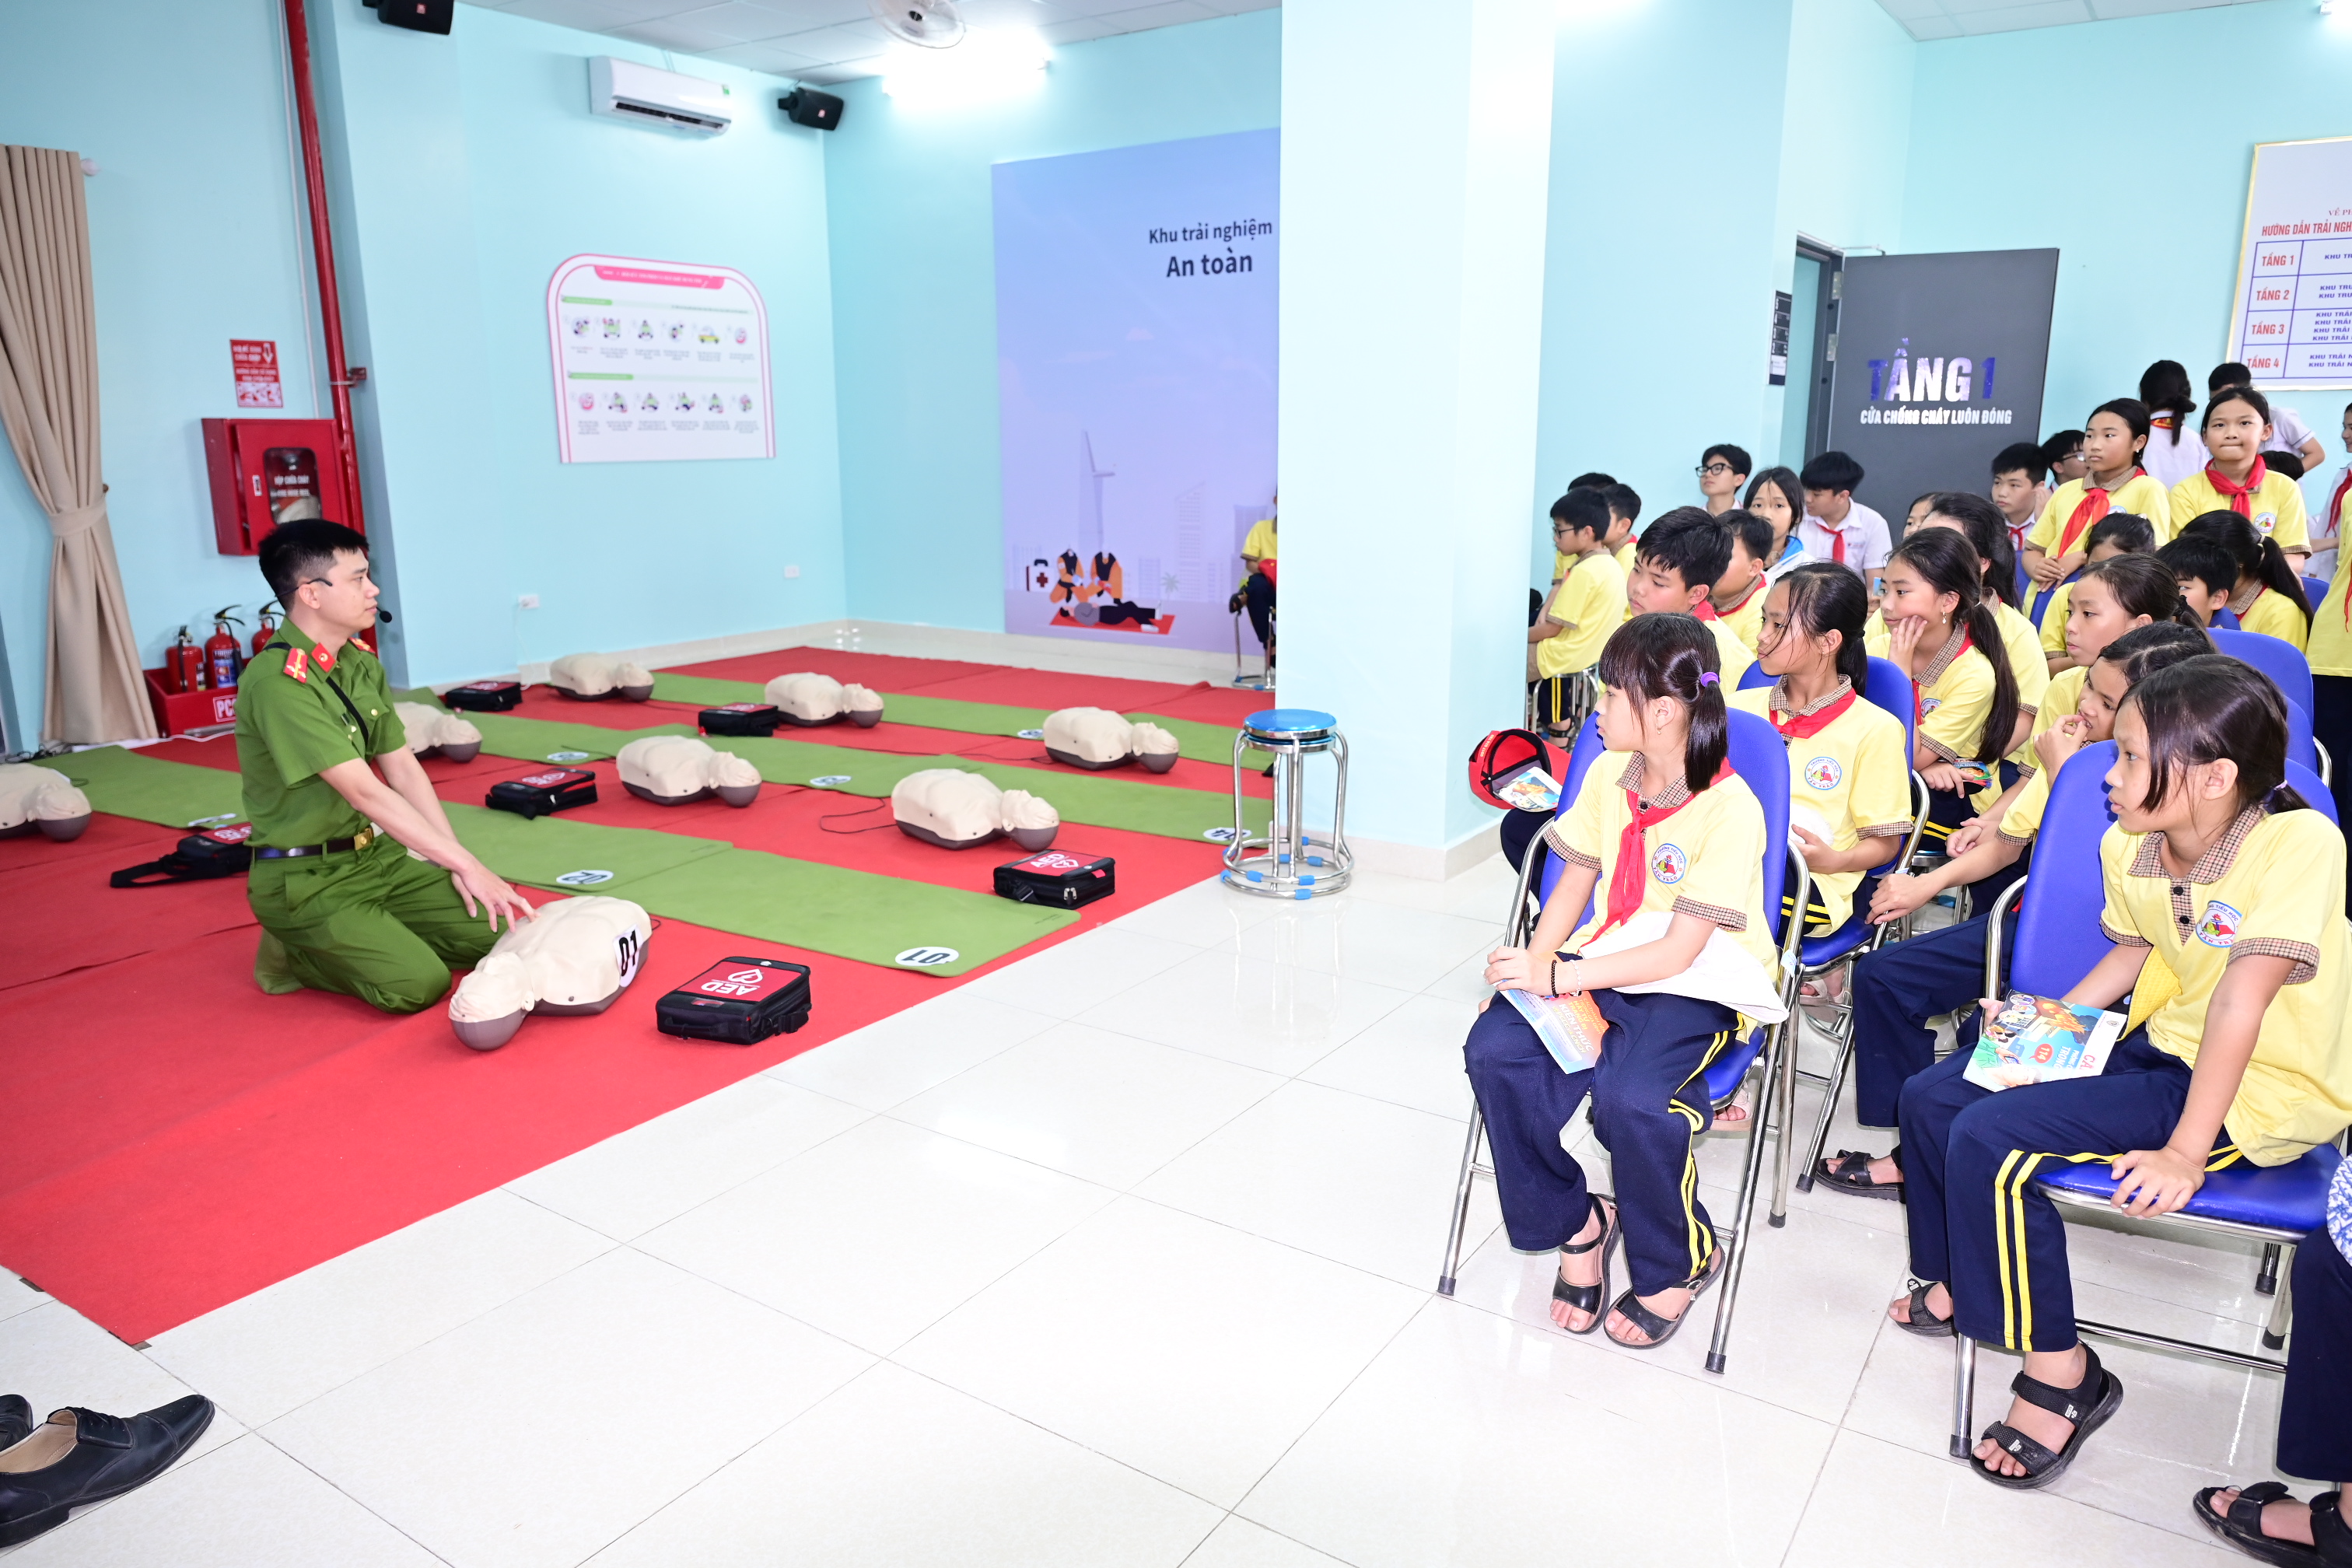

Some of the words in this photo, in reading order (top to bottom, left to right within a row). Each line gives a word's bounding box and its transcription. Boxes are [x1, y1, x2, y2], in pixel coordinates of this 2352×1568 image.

[1149, 227, 1178, 244] Khu
[1182, 222, 1209, 241] trải
[1213, 218, 1272, 243] nghiệm
[1167, 256, 1194, 278] An
[1201, 247, 1253, 275] toàn
[2290, 254, 2295, 265] 1
[2283, 289, 2290, 300] 2
[2278, 324, 2285, 334] 3
[1868, 338, 1972, 402] TẦNG
[1981, 357, 1996, 399] 1
[2273, 358, 2280, 368] 4
[1860, 405, 1882, 425] CỬA
[1883, 405, 1920, 425] CHỐNG
[1921, 407, 1951, 425] CHÁY
[1951, 407, 1980, 425] LUÔN
[1981, 407, 2012, 425] ĐÓNG
[619, 929, 638, 977] 01
[901, 950, 950, 964] 01
[701, 982, 758, 996] AED
[1558, 1003, 1579, 1024] KIẾN
[1572, 1026, 1596, 1052] THỨC
[2036, 1047, 2050, 1061] 114
